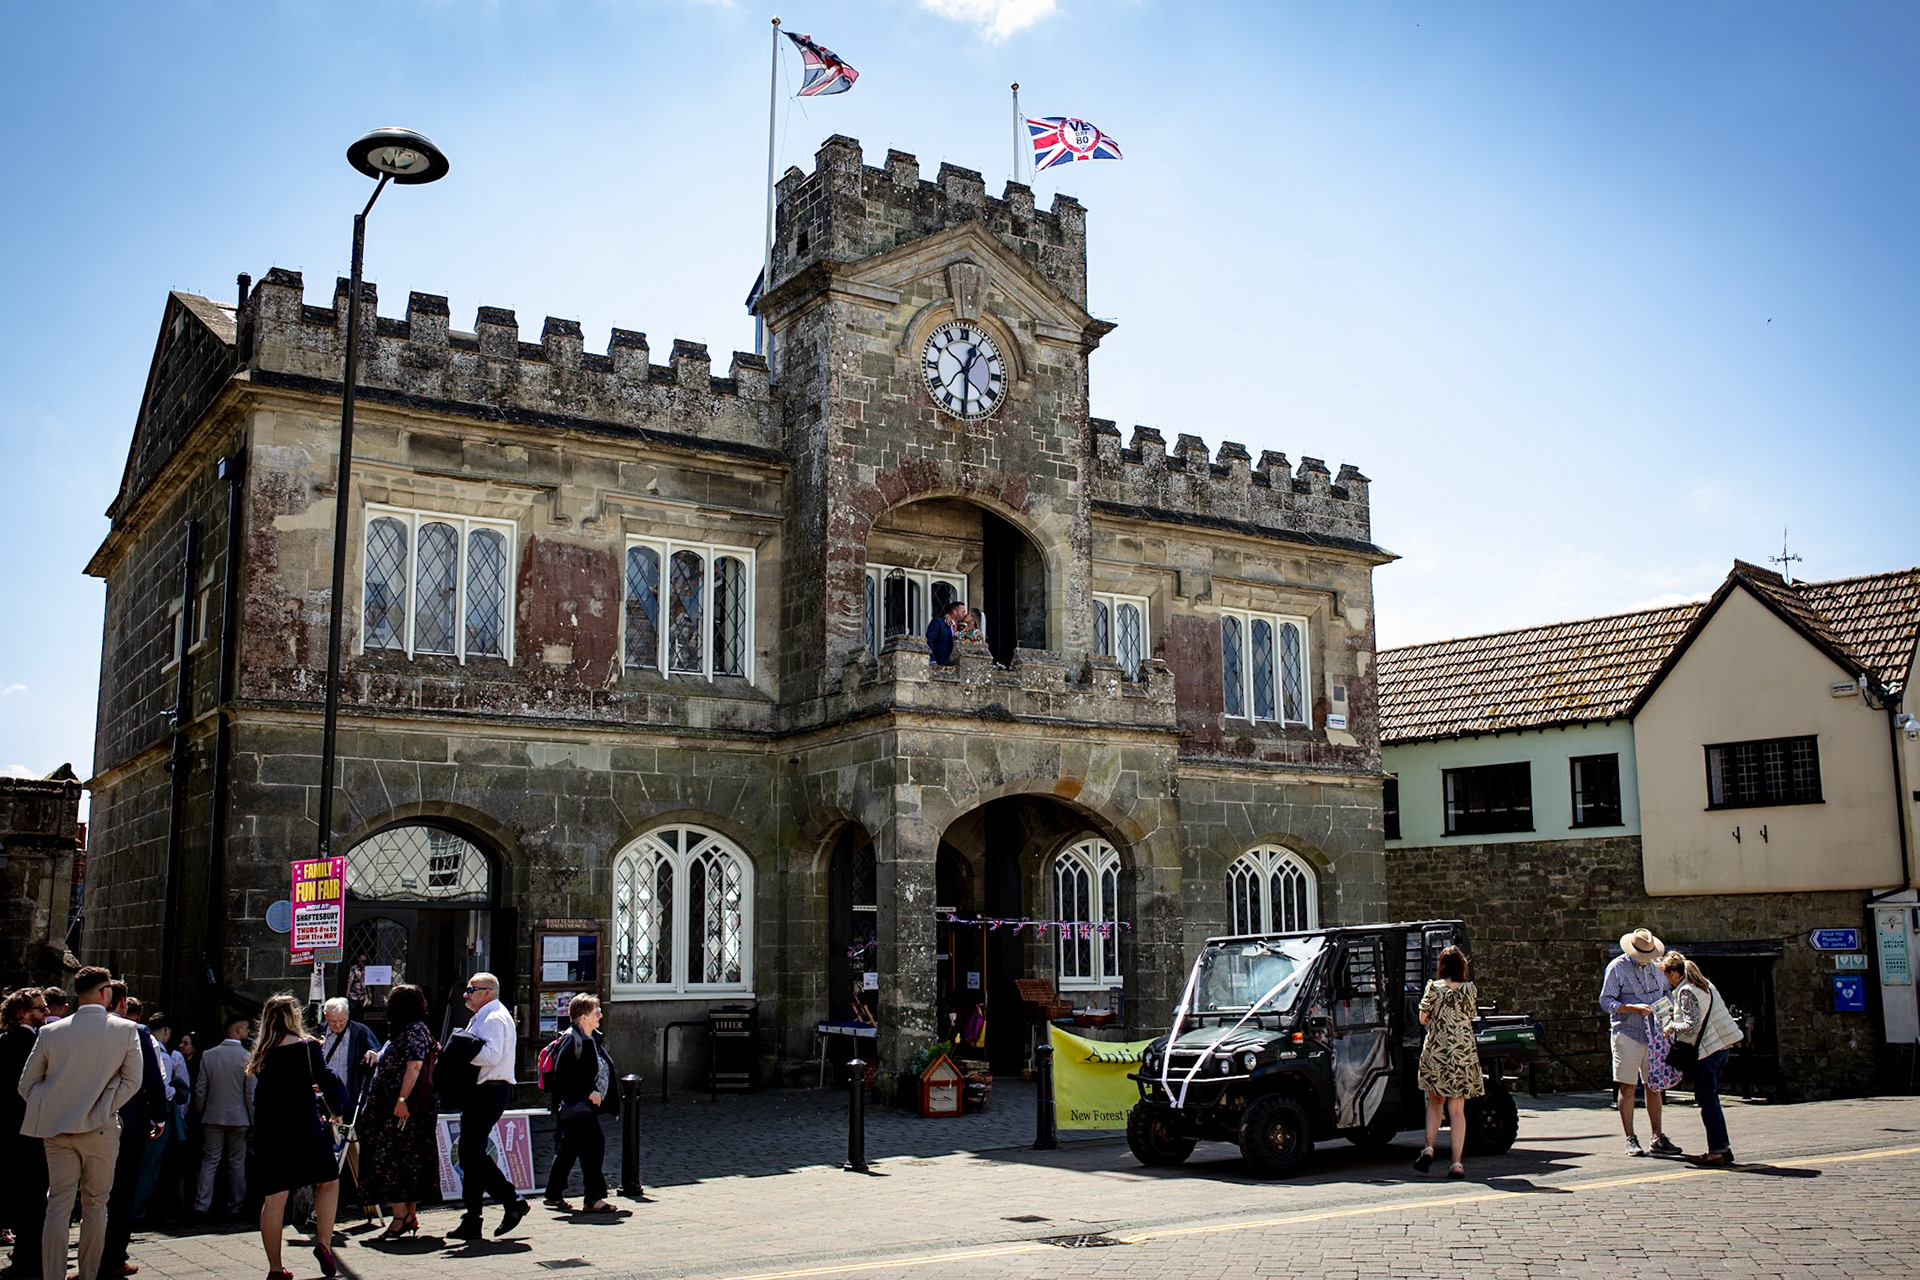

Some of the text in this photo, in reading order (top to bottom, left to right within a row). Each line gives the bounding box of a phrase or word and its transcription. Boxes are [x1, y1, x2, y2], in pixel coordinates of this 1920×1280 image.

[1069, 121, 1090, 132] VE
[1076, 136, 1089, 144] 80
[304, 862, 333, 879] FAMILY
[296, 879, 340, 903] FUN FAIR
[296, 912, 338, 922] SHAFTESBURY
[716, 1021, 743, 1029] LITTER
[1071, 1109, 1091, 1121] New
[1093, 1109, 1124, 1121] Forest
[442, 1154, 457, 1193] PHOTOGRAPHY
